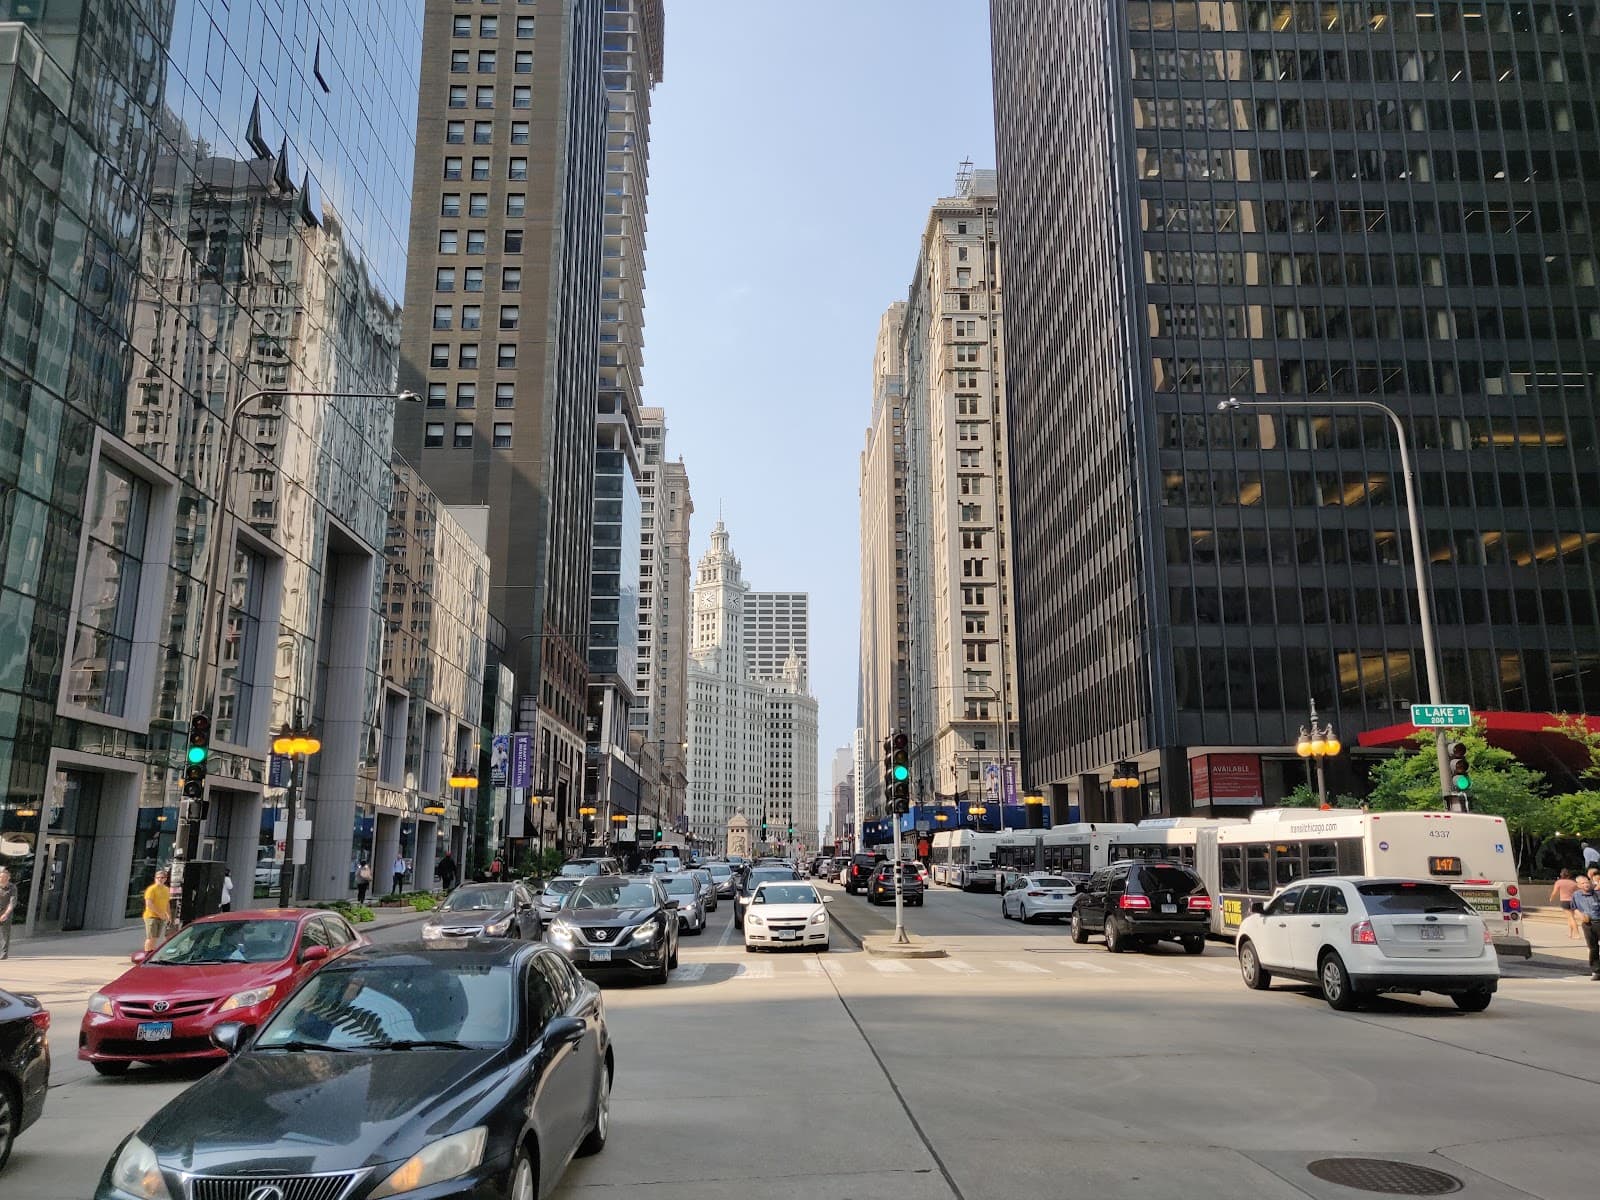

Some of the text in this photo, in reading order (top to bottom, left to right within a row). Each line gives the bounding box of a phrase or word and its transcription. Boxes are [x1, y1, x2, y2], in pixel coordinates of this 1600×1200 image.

[1425, 708, 1454, 717] LAKE
[1213, 765, 1249, 773] AVAILABLE
[1436, 858, 1453, 871] 147
